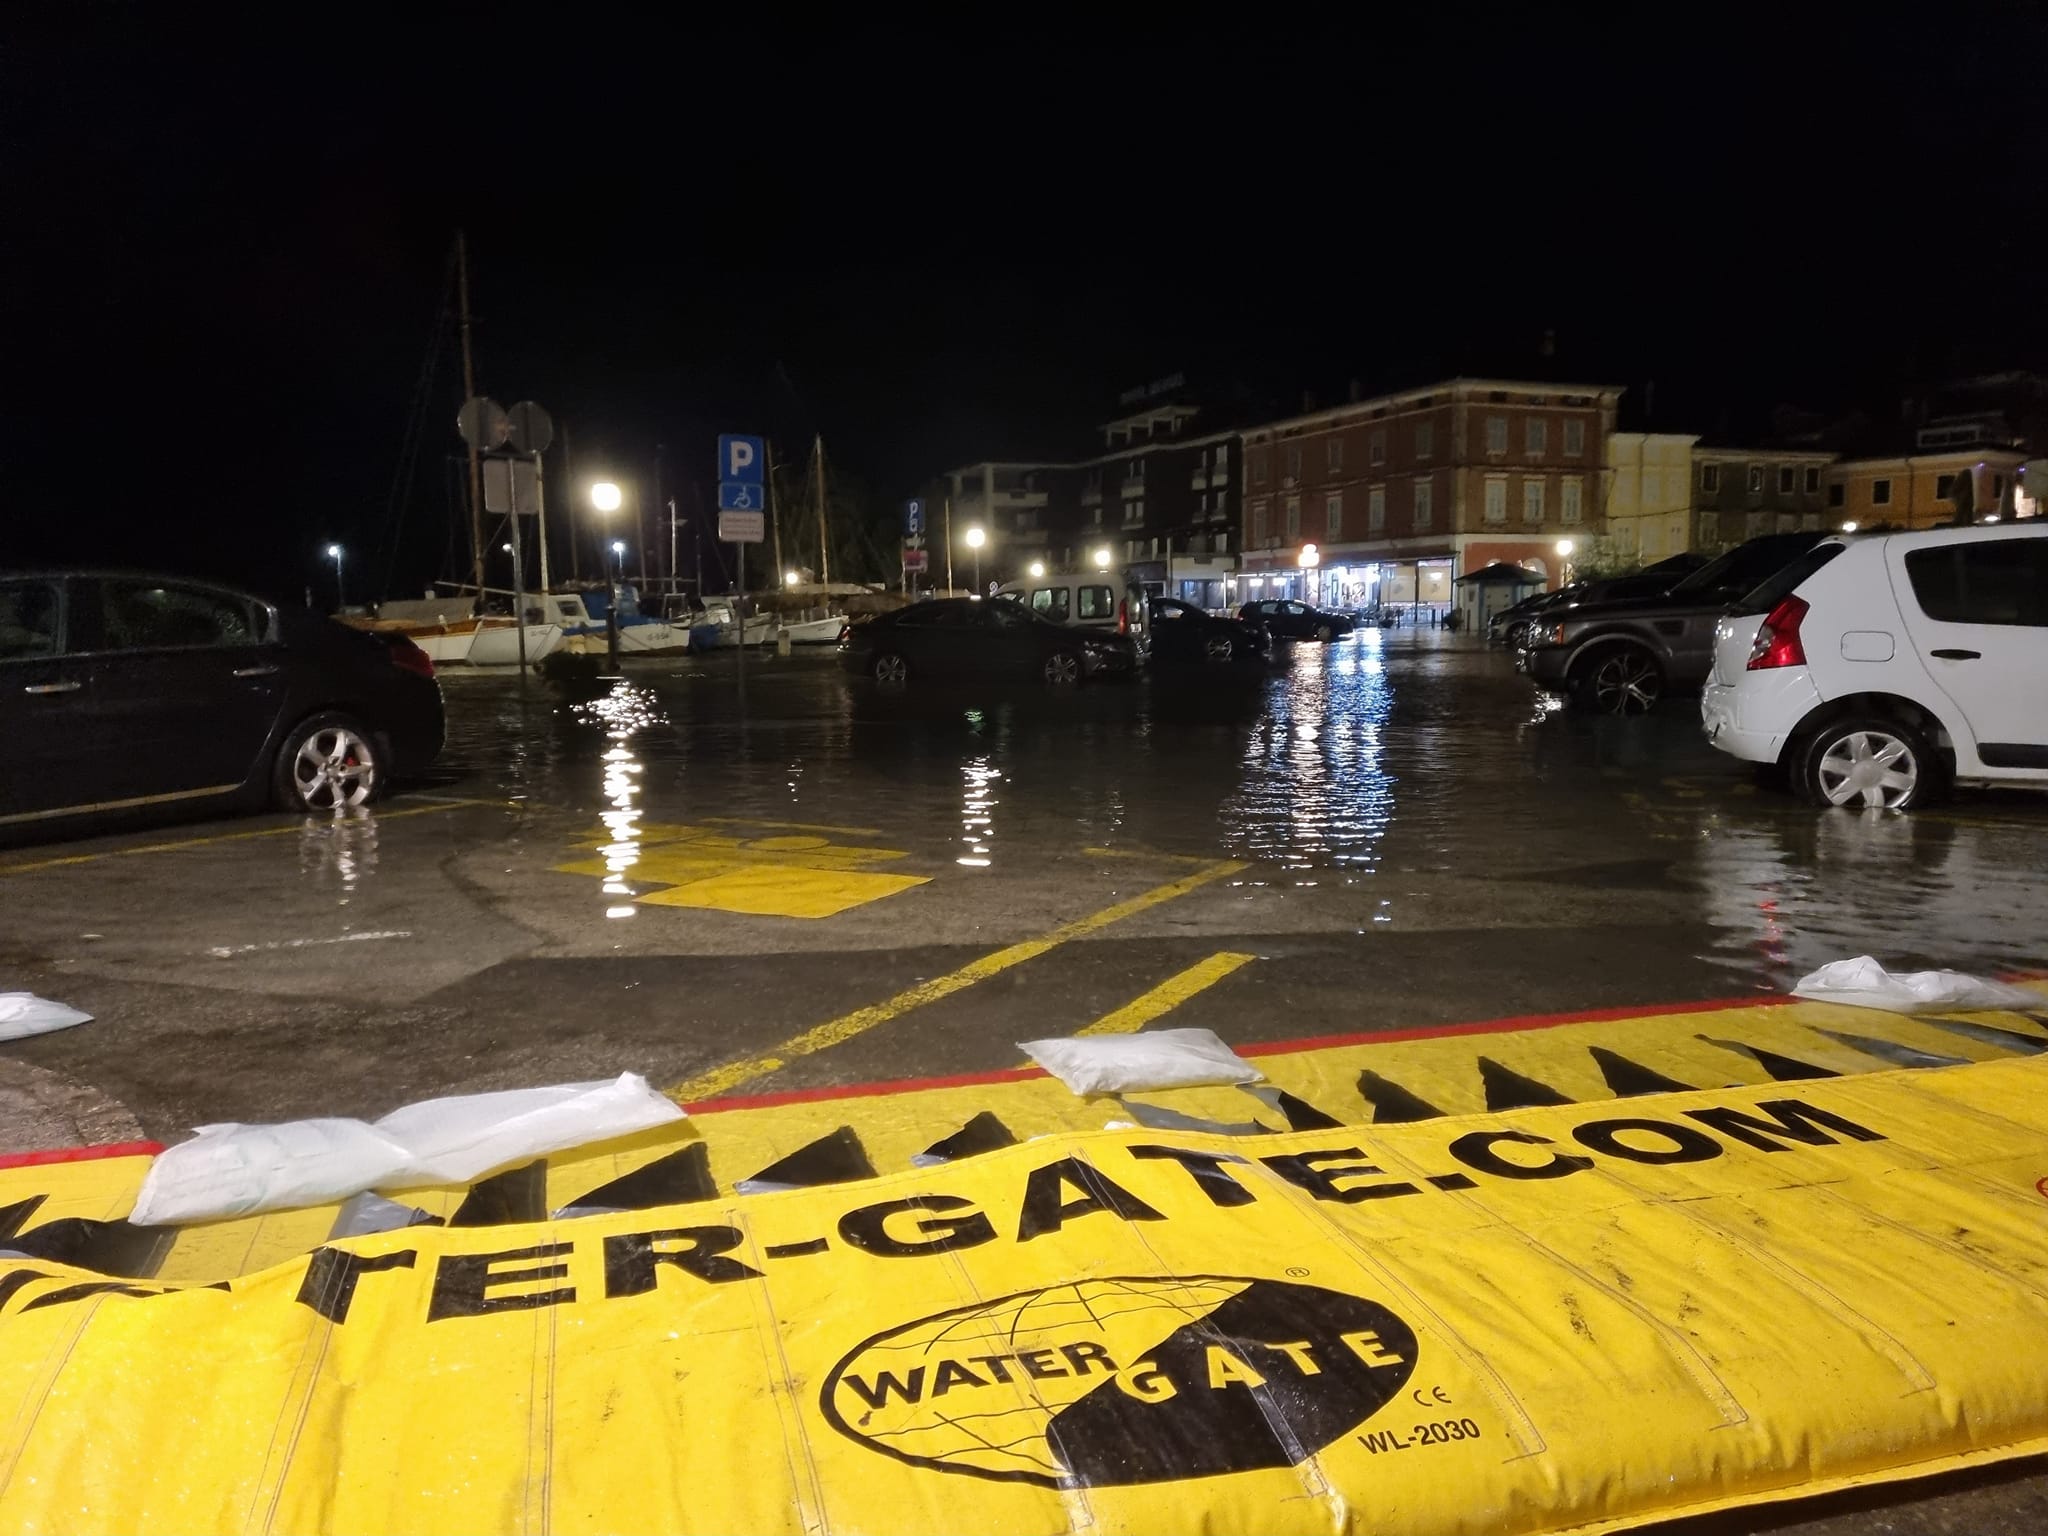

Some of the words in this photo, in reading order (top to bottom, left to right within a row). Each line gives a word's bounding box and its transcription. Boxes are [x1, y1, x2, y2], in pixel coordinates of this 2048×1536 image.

[730, 441, 753, 476] P
[0, 1098, 1888, 1325] TER-GATE.COM
[841, 1341, 1119, 1409] WATER
[1115, 1331, 1404, 1404] GATE
[1357, 1418, 1481, 1455] WL-2030
